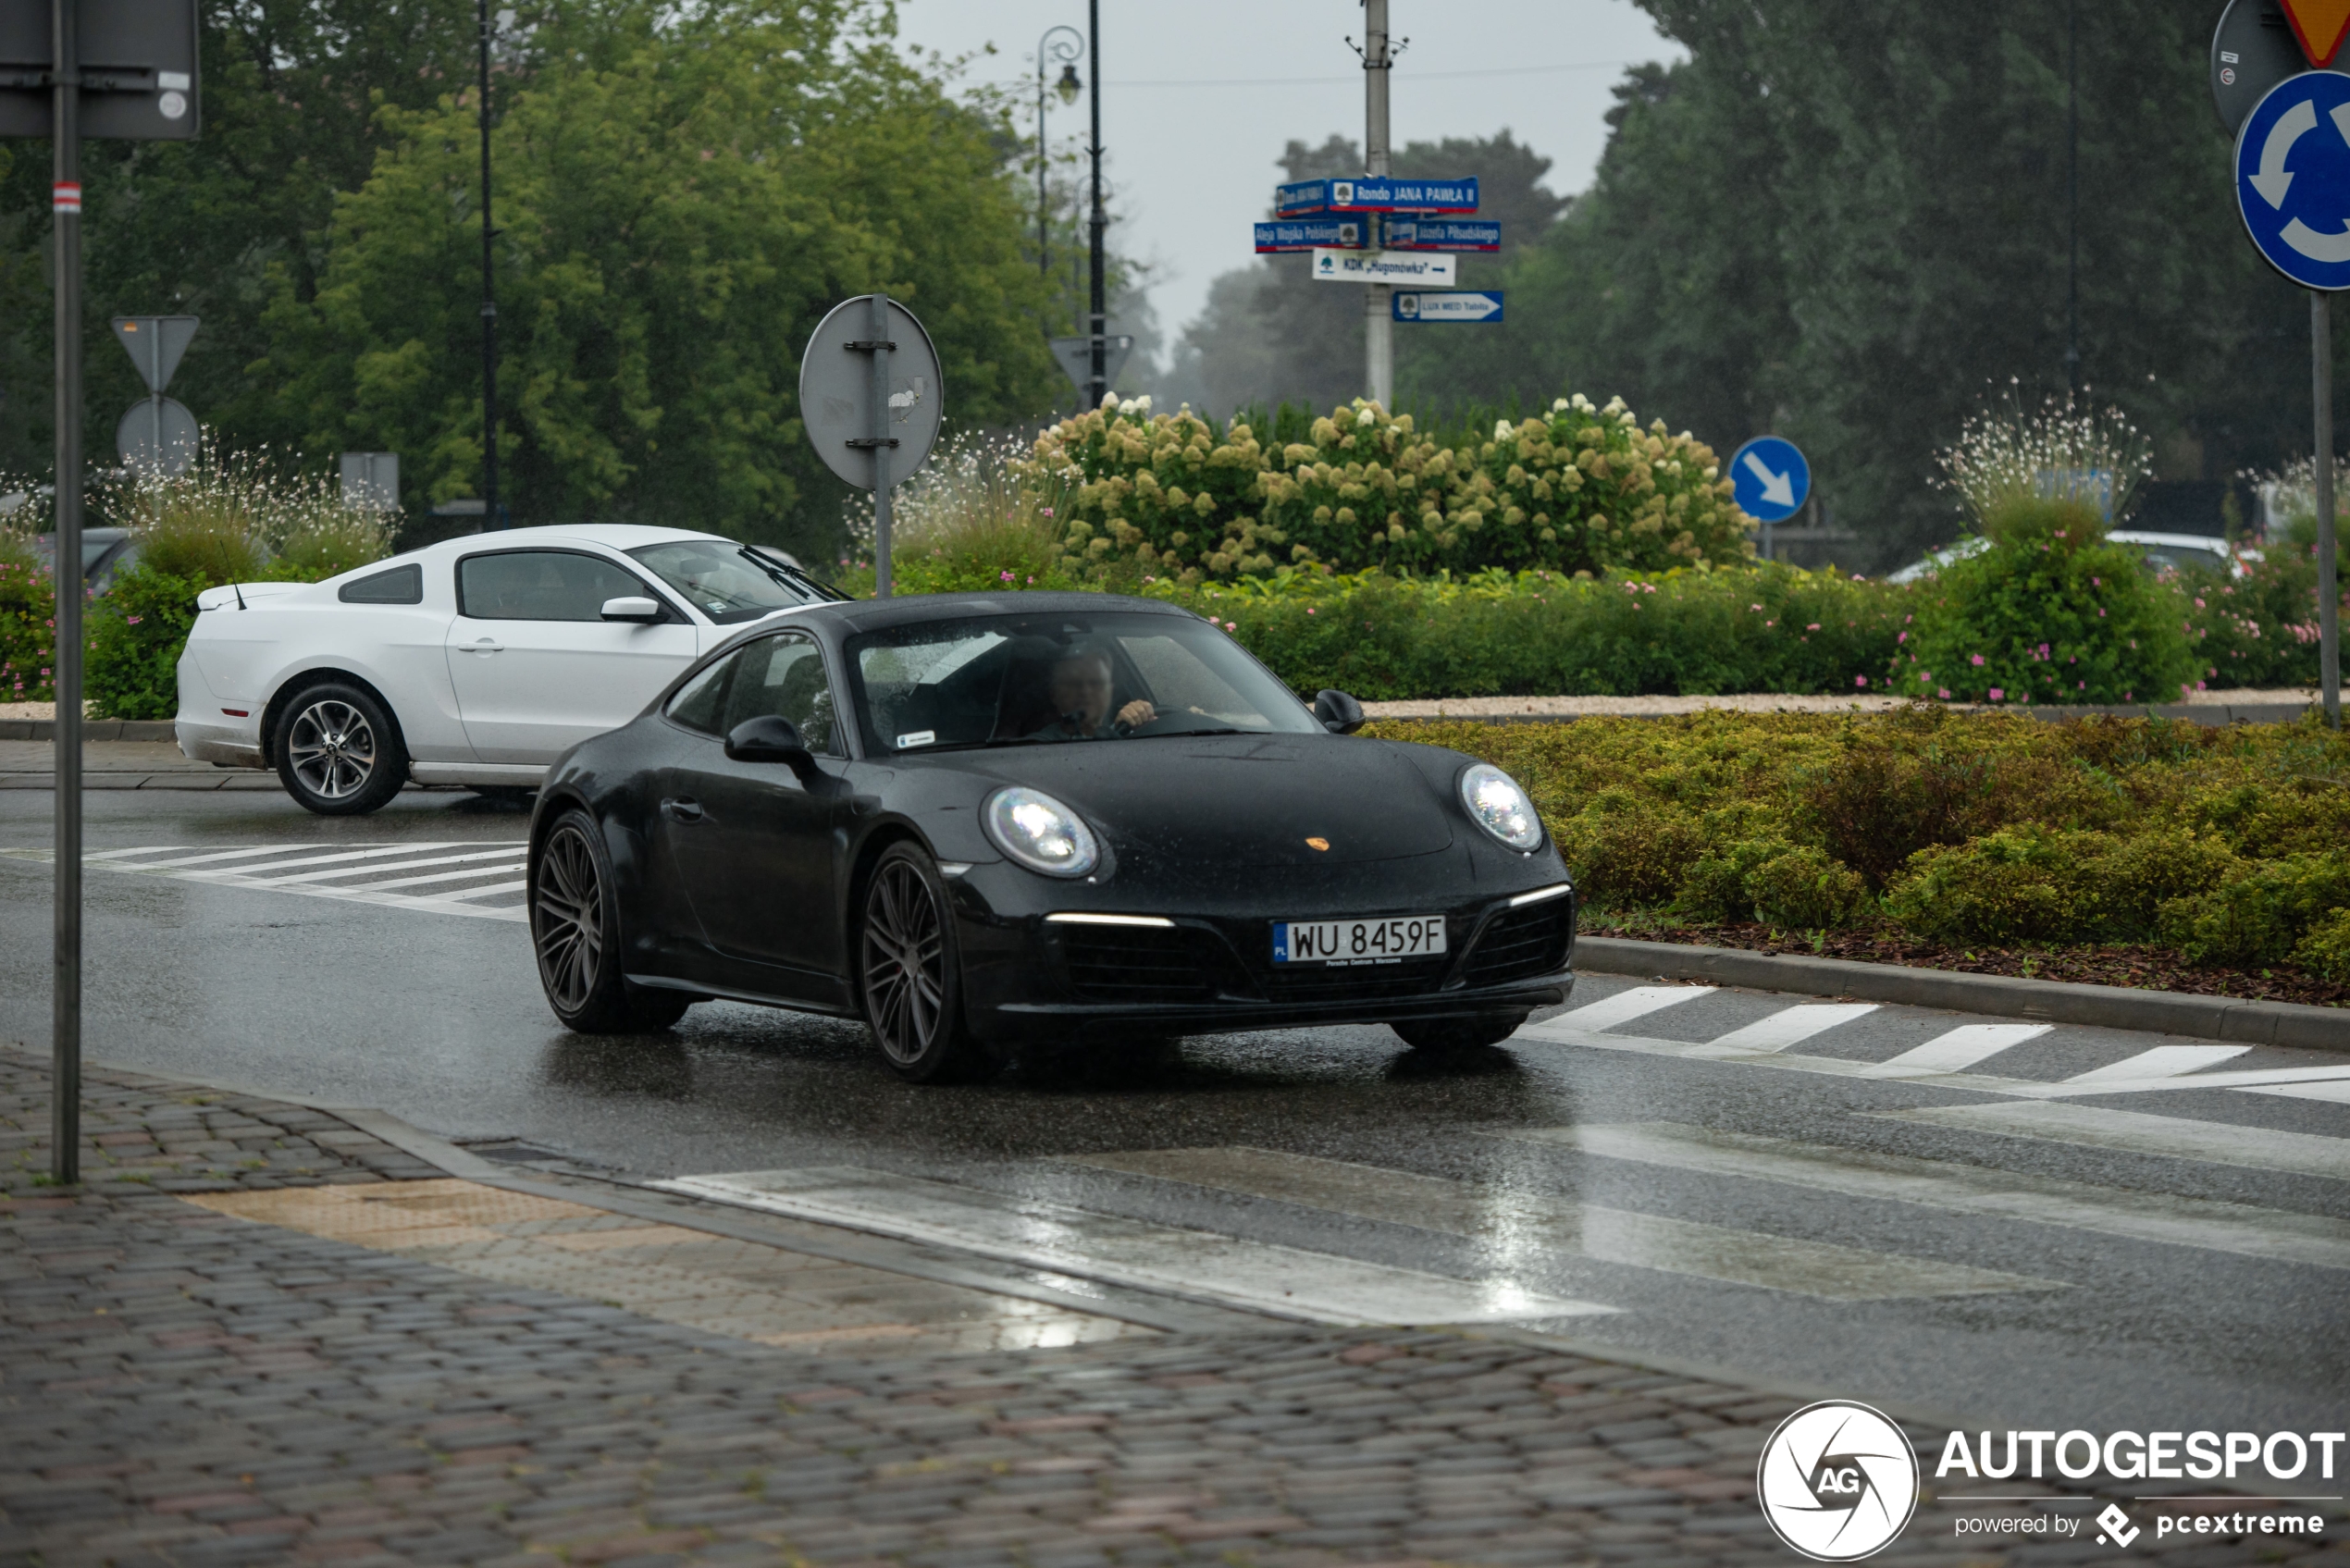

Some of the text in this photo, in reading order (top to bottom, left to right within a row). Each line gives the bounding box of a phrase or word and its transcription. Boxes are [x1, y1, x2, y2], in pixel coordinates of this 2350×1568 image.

[1357, 186, 1474, 203] Rondo JANA PAWŁA II
[1255, 227, 1275, 244] Aleja
[1276, 226, 1304, 243] Wojska
[1343, 258, 1365, 271] KDK
[1423, 302, 1440, 310] LUX
[1441, 302, 1462, 311] MED
[1275, 919, 1442, 958] PL WU 8459F
